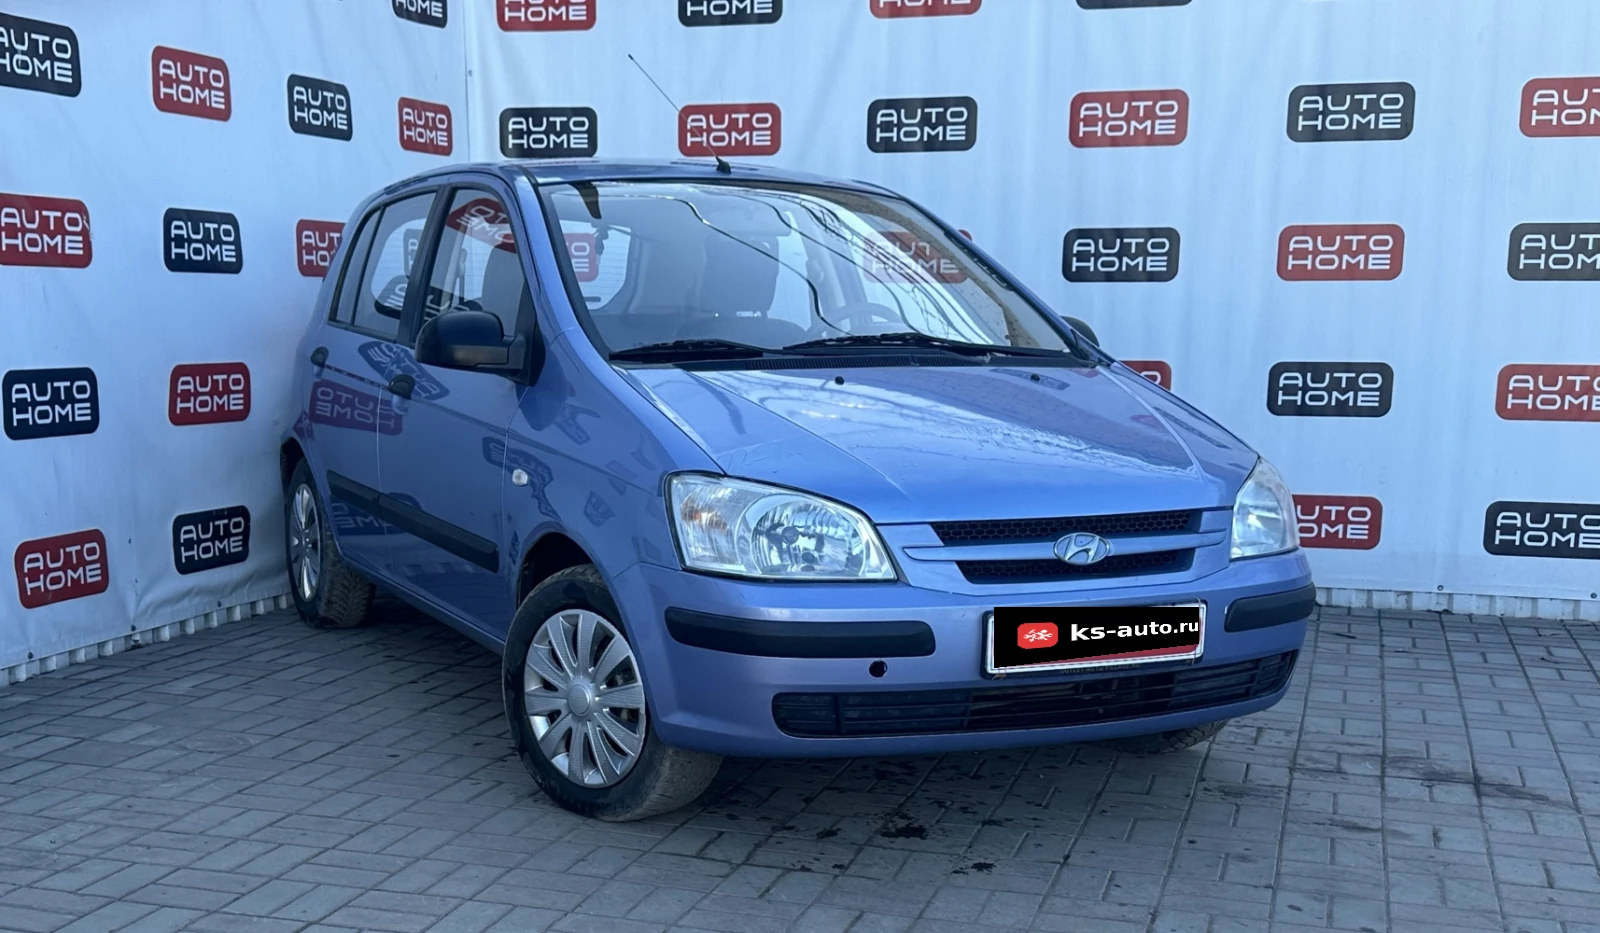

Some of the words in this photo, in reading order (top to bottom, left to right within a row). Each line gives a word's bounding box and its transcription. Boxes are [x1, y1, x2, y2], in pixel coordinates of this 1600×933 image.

[505, 6, 586, 21] HOME
[687, 0, 772, 16] HOME
[159, 58, 226, 89] AUTO
[160, 81, 226, 109] HOME
[293, 86, 347, 111] AUTO
[1299, 94, 1403, 111] AUTO
[294, 104, 348, 130] HOME
[402, 108, 447, 129] AUTO
[877, 107, 967, 124] AUTO
[1080, 101, 1178, 118] AUTO
[508, 117, 589, 132] AUTO
[687, 113, 772, 129] AUTO
[1079, 119, 1176, 137] HOME
[1298, 113, 1401, 131] HOME
[403, 125, 448, 146] HOME
[509, 134, 588, 148] HOME
[687, 131, 771, 146] HOME
[876, 125, 966, 142] HOME
[1, 208, 82, 231] AUTO
[171, 221, 234, 241] AUTO
[2, 232, 83, 254] HOME
[171, 242, 236, 262] HOME
[1073, 238, 1169, 253] AUTO
[1289, 235, 1393, 251] AUTO
[1072, 257, 1167, 271] HOME
[1288, 254, 1390, 269] HOME
[1520, 254, 1600, 269] HOM
[178, 374, 244, 393] AUTO
[1279, 373, 1382, 388] AUTO
[12, 381, 91, 402] AUTO
[1278, 391, 1379, 406] HOME
[177, 394, 243, 413] HOME
[13, 403, 91, 426] HOME
[180, 517, 245, 542] AUTO
[1497, 512, 1600, 530] AUTO
[1495, 530, 1600, 548] HOME
[24, 541, 100, 573] AUTO
[181, 536, 244, 563] HOME
[25, 563, 102, 595] HOME
